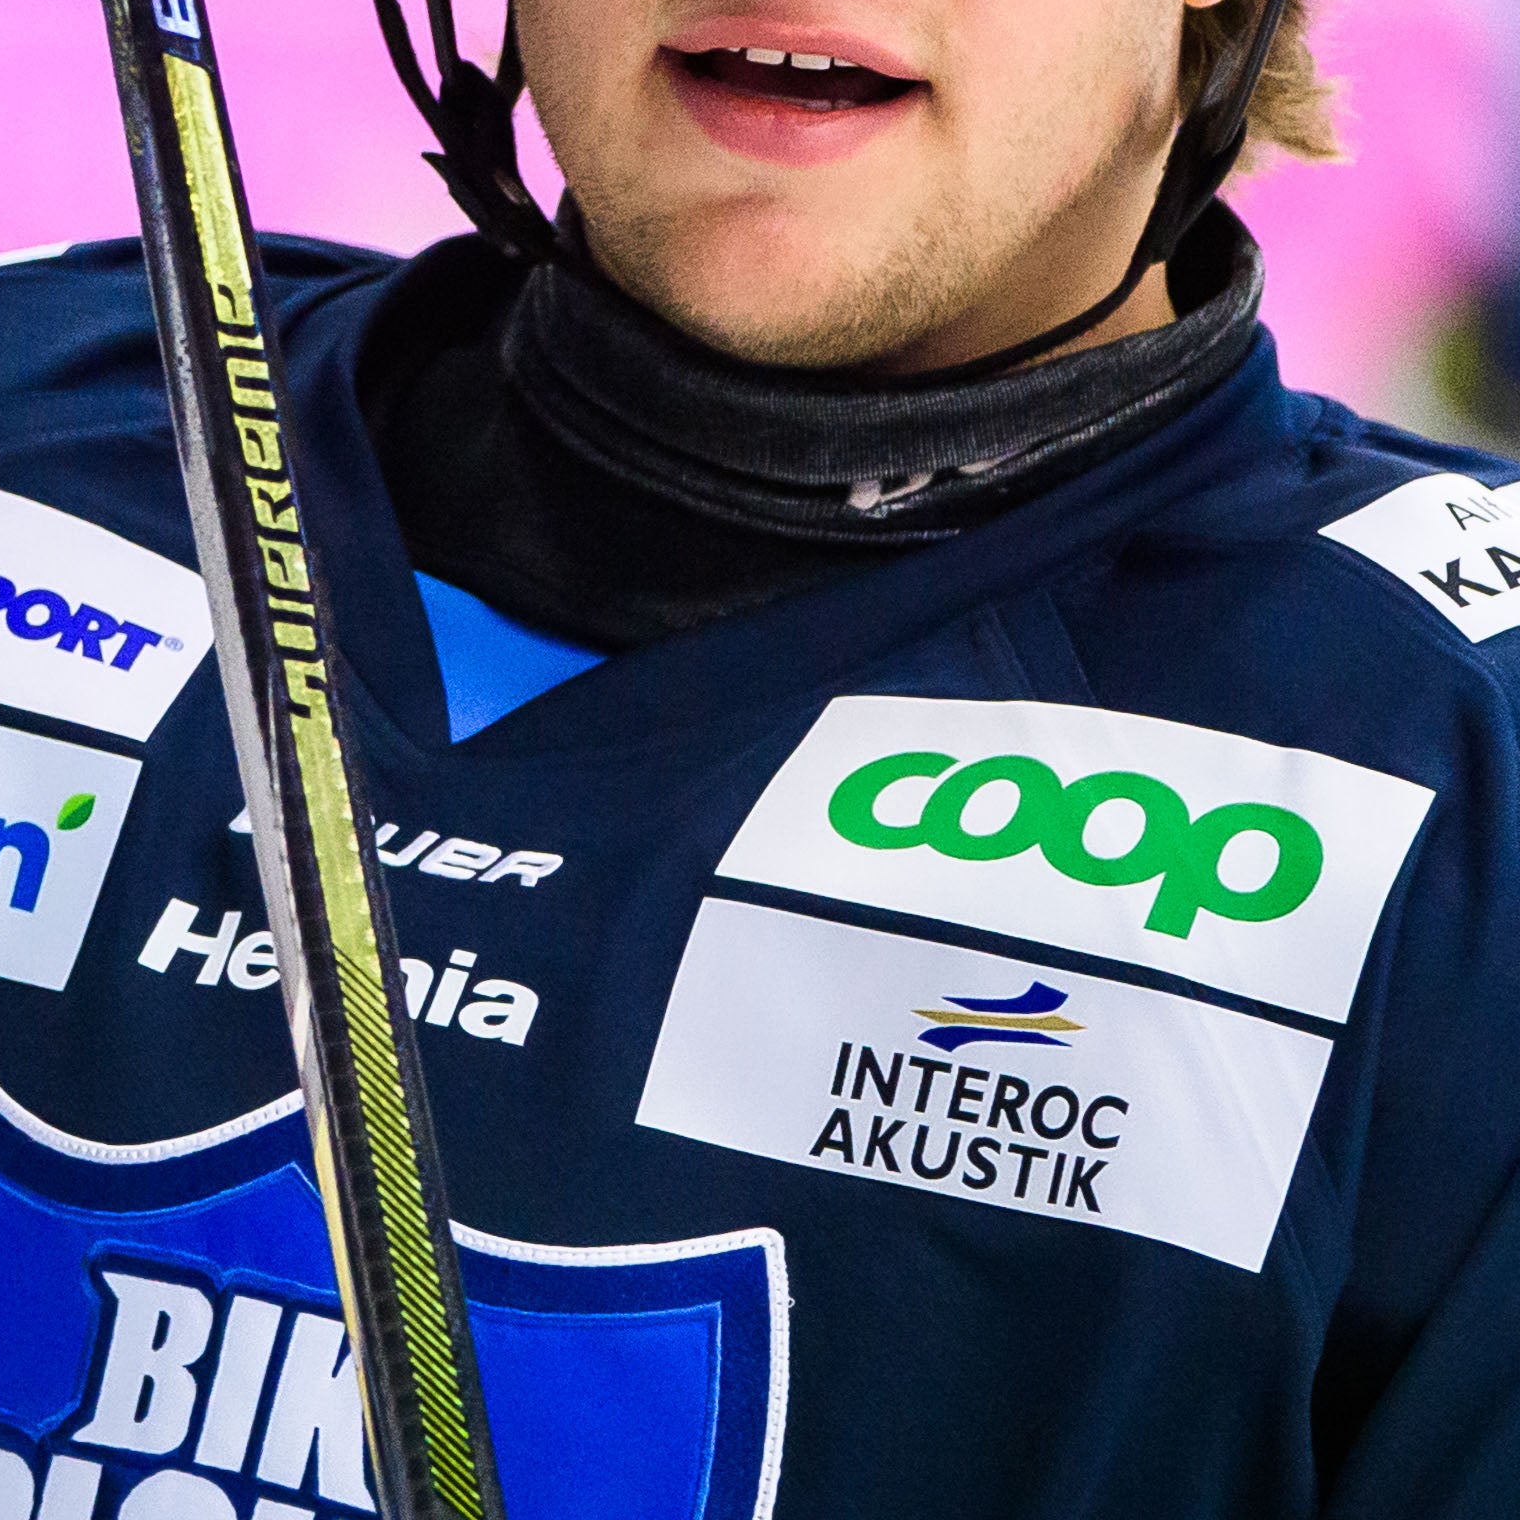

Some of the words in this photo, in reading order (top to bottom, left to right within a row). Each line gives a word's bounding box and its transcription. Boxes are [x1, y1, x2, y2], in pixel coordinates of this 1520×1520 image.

[828, 751, 1323, 939] coop
[809, 1107, 1109, 1213] AKUSTIK
[831, 1041, 1129, 1149] INTEROC
[72, 1271, 377, 1513] BIK
